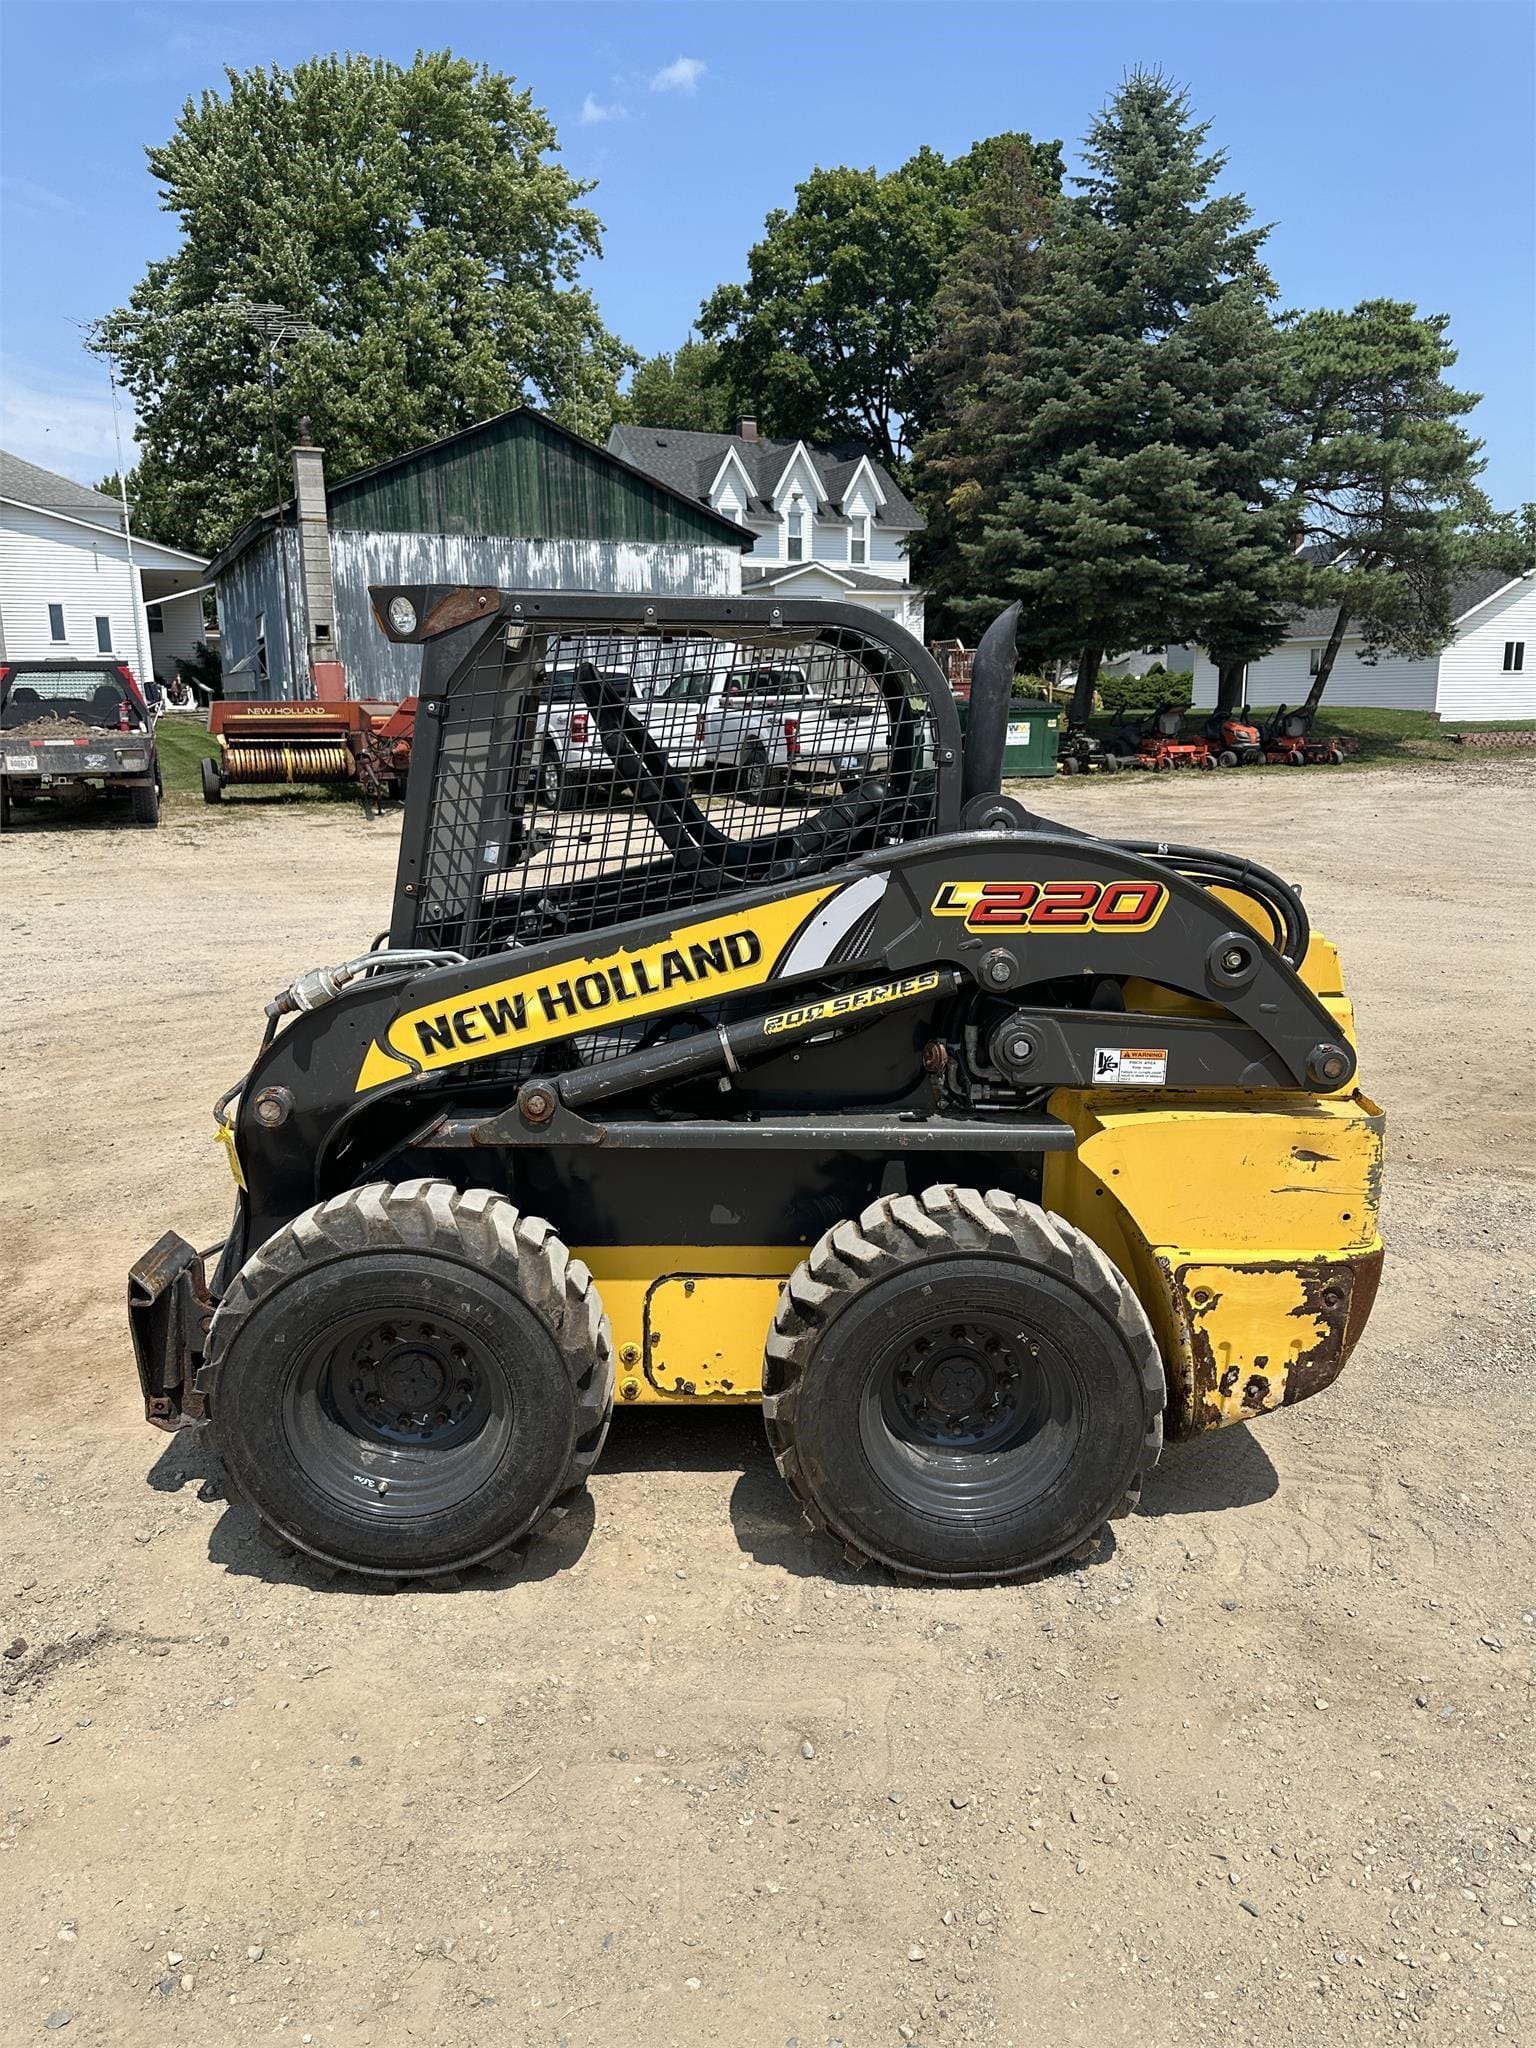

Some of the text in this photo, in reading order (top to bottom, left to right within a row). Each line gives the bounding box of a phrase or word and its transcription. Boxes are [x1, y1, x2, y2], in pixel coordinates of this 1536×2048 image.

[932, 882, 1168, 931] L220
[414, 929, 761, 1057] NEW HOLLAND
[833, 971, 936, 1012] SERIES
